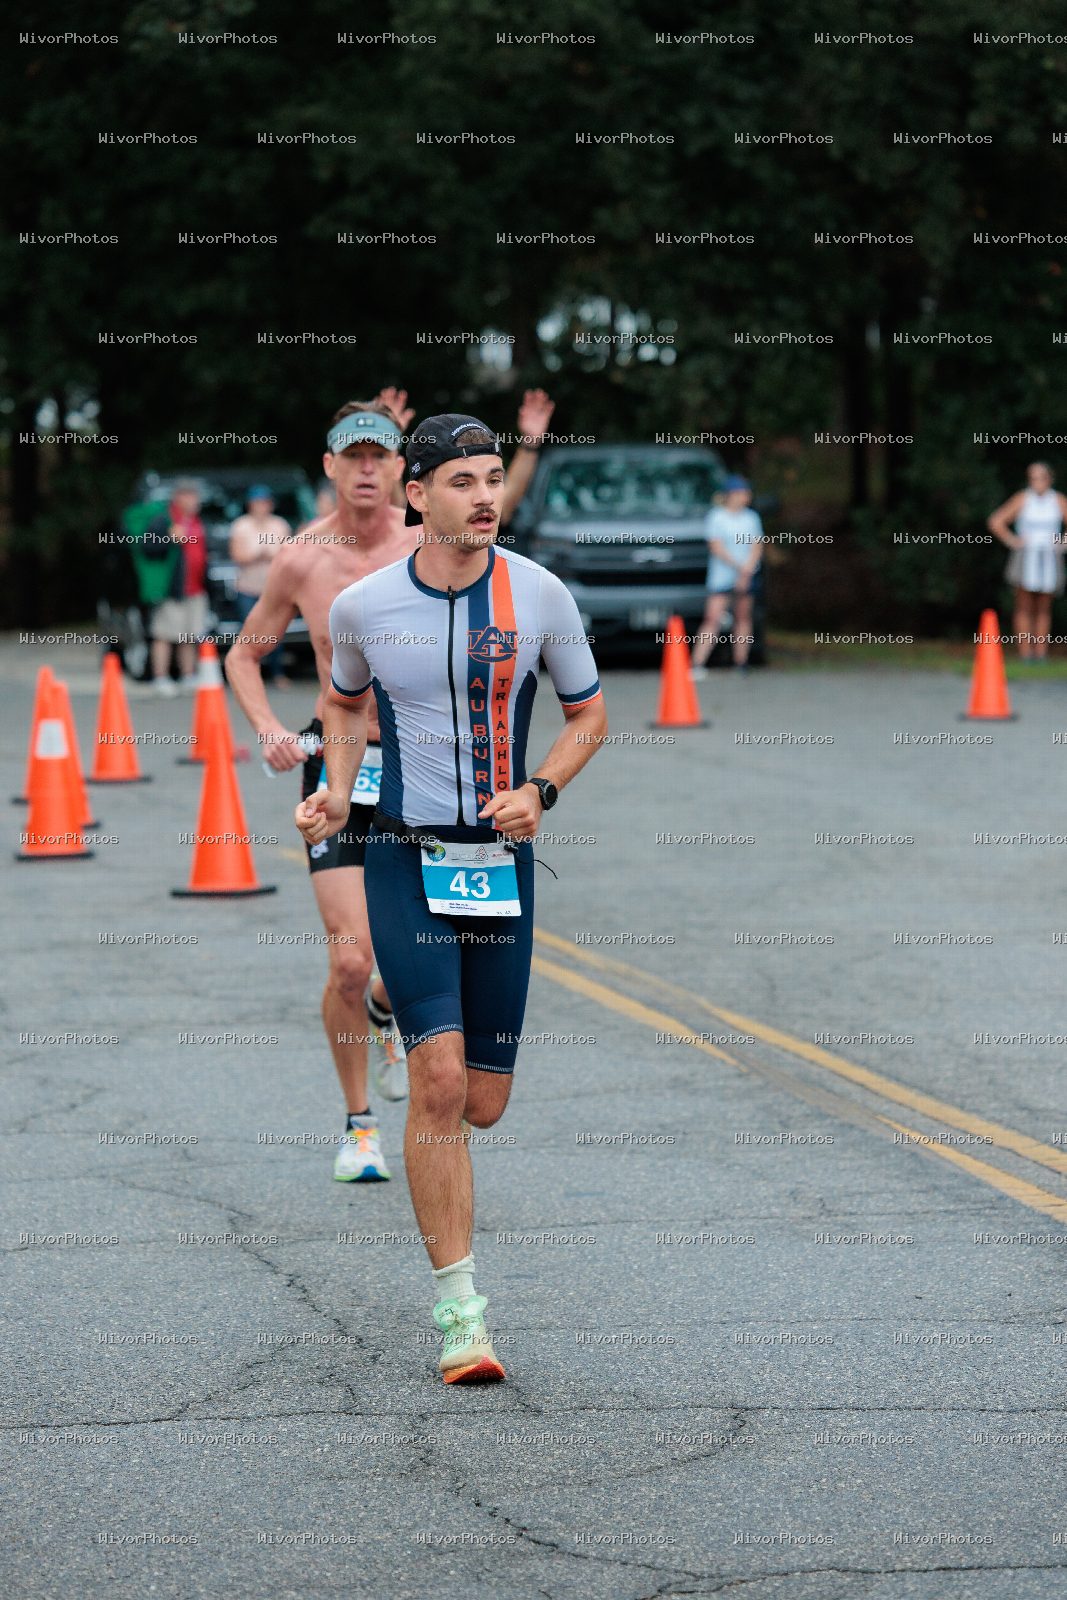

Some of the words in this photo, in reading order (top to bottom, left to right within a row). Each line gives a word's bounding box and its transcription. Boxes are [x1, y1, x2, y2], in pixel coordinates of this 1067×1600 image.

[470, 677, 491, 806] AUBURN
[495, 678, 509, 791] TRIAHLO
[449, 870, 491, 899] 43
